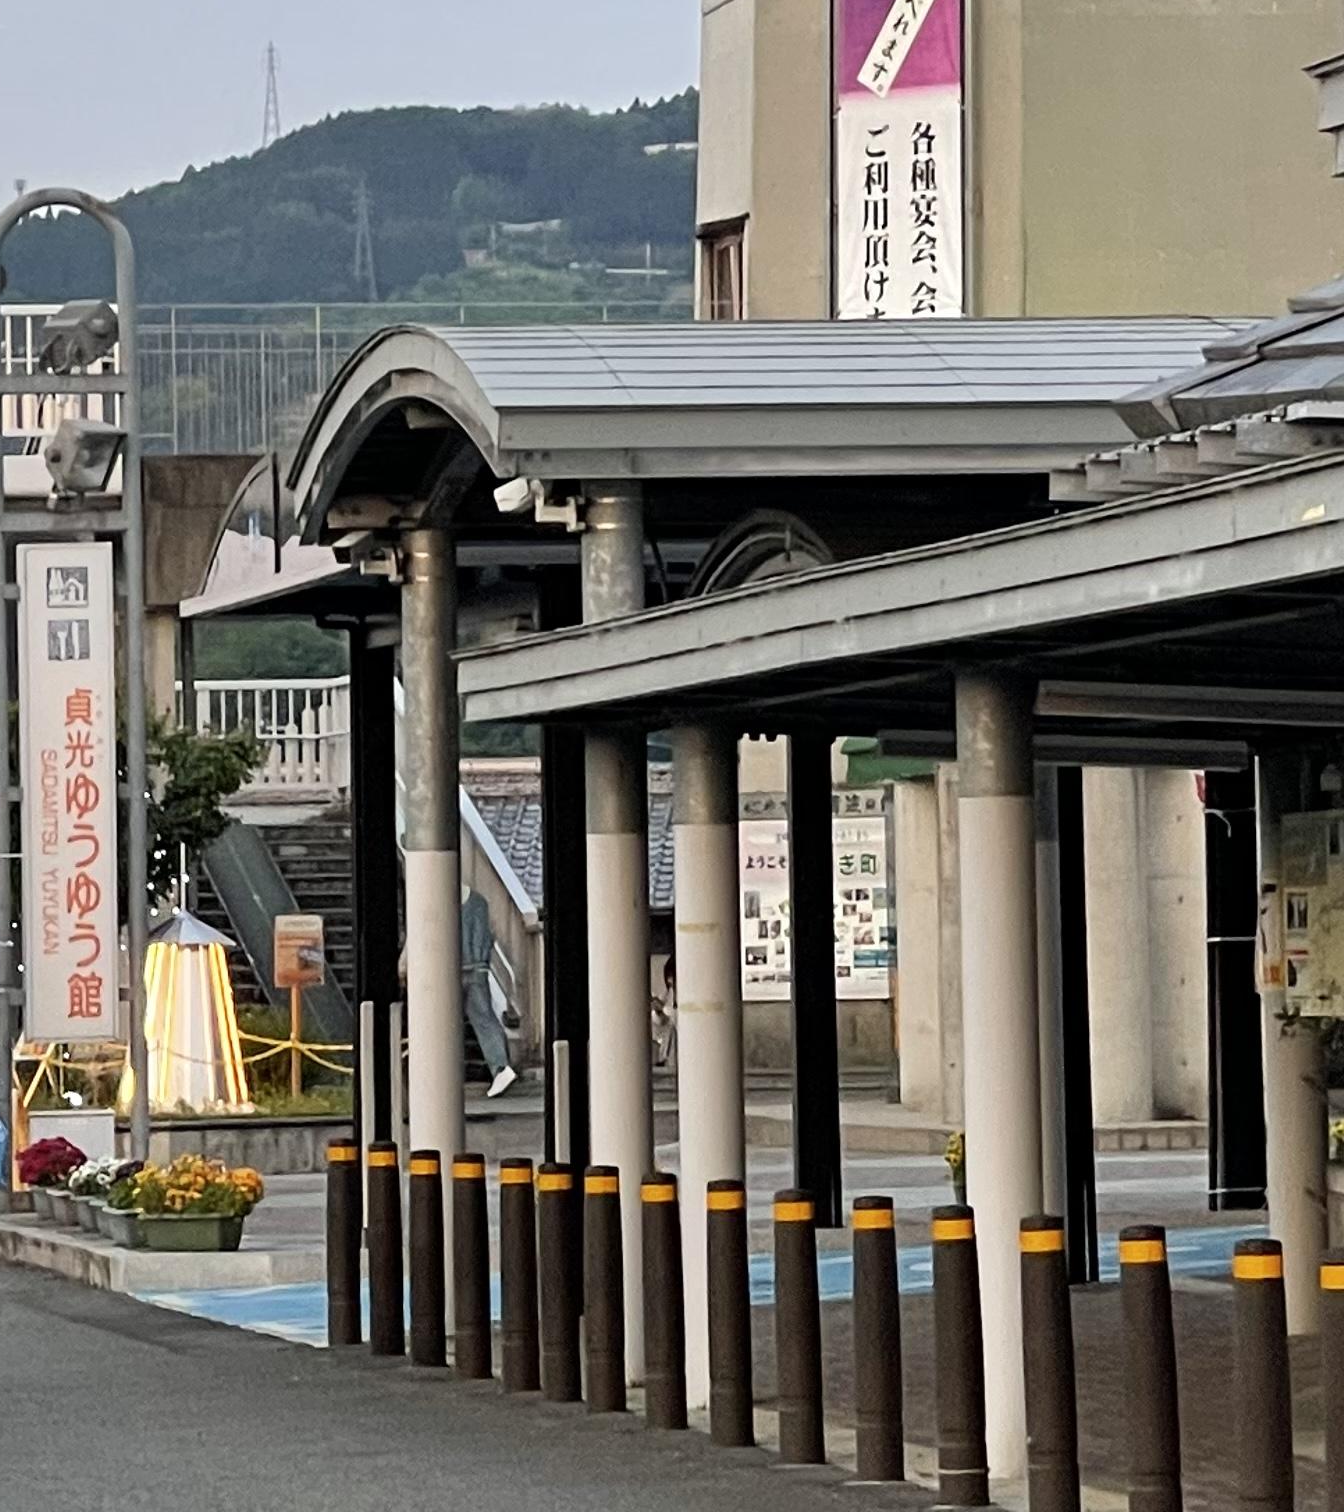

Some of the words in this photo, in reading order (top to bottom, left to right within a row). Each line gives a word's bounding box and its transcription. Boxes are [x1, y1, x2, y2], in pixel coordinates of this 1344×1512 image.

[41, 748, 59, 856] SADAMITSU
[64, 688, 103, 1019] 貞光ゆうゆう館
[42, 867, 60, 956] YUYUKAN
